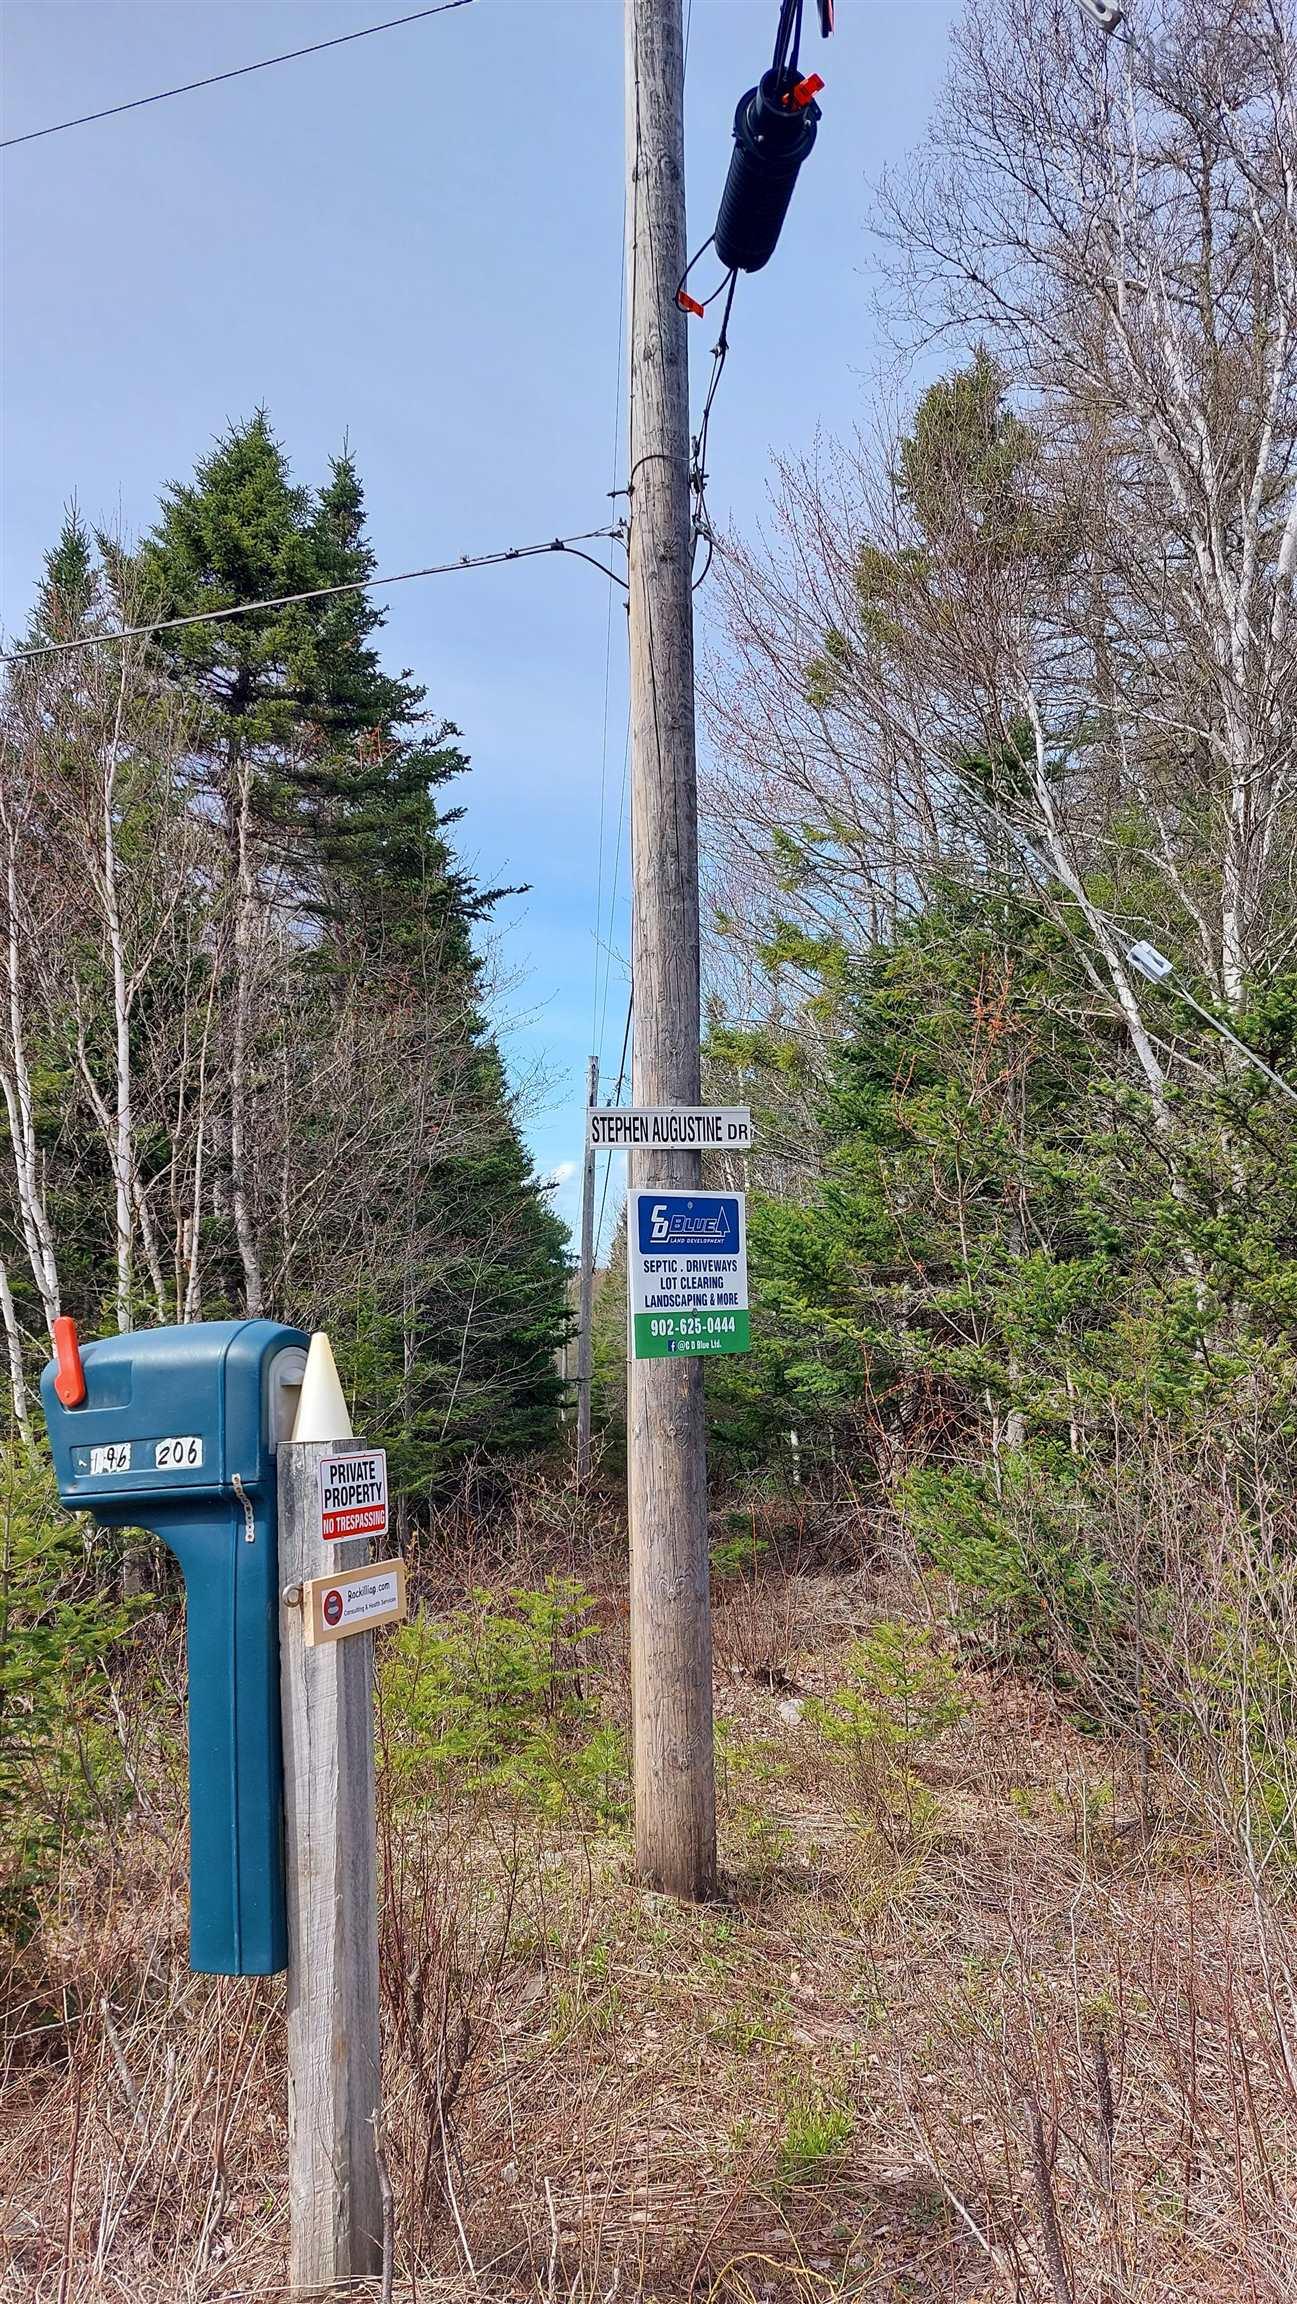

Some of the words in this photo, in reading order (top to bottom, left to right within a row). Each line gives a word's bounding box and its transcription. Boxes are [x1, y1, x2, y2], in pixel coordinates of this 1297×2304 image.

[592, 1116, 648, 1142] STEPHEN
[653, 1116, 722, 1142] AUGUSTINE
[728, 1124, 748, 1140] DR
[643, 1260, 678, 1273] SEPTIC
[686, 1259, 738, 1273] DRIVEWAYS
[660, 1277, 677, 1290] LOT
[680, 1276, 724, 1290] CLEARING
[645, 1294, 708, 1308] LANDSCAPING
[710, 1294, 715, 1306] &
[717, 1292, 739, 1305] MORE
[650, 1316, 736, 1337] 902-625-0444
[158, 1440, 198, 1466] 206
[330, 1460, 376, 1484] PRIVATE
[324, 1482, 382, 1508] PROPERTY
[323, 1518, 335, 1535] NO
[336, 1510, 385, 1532] TRESPASSING
